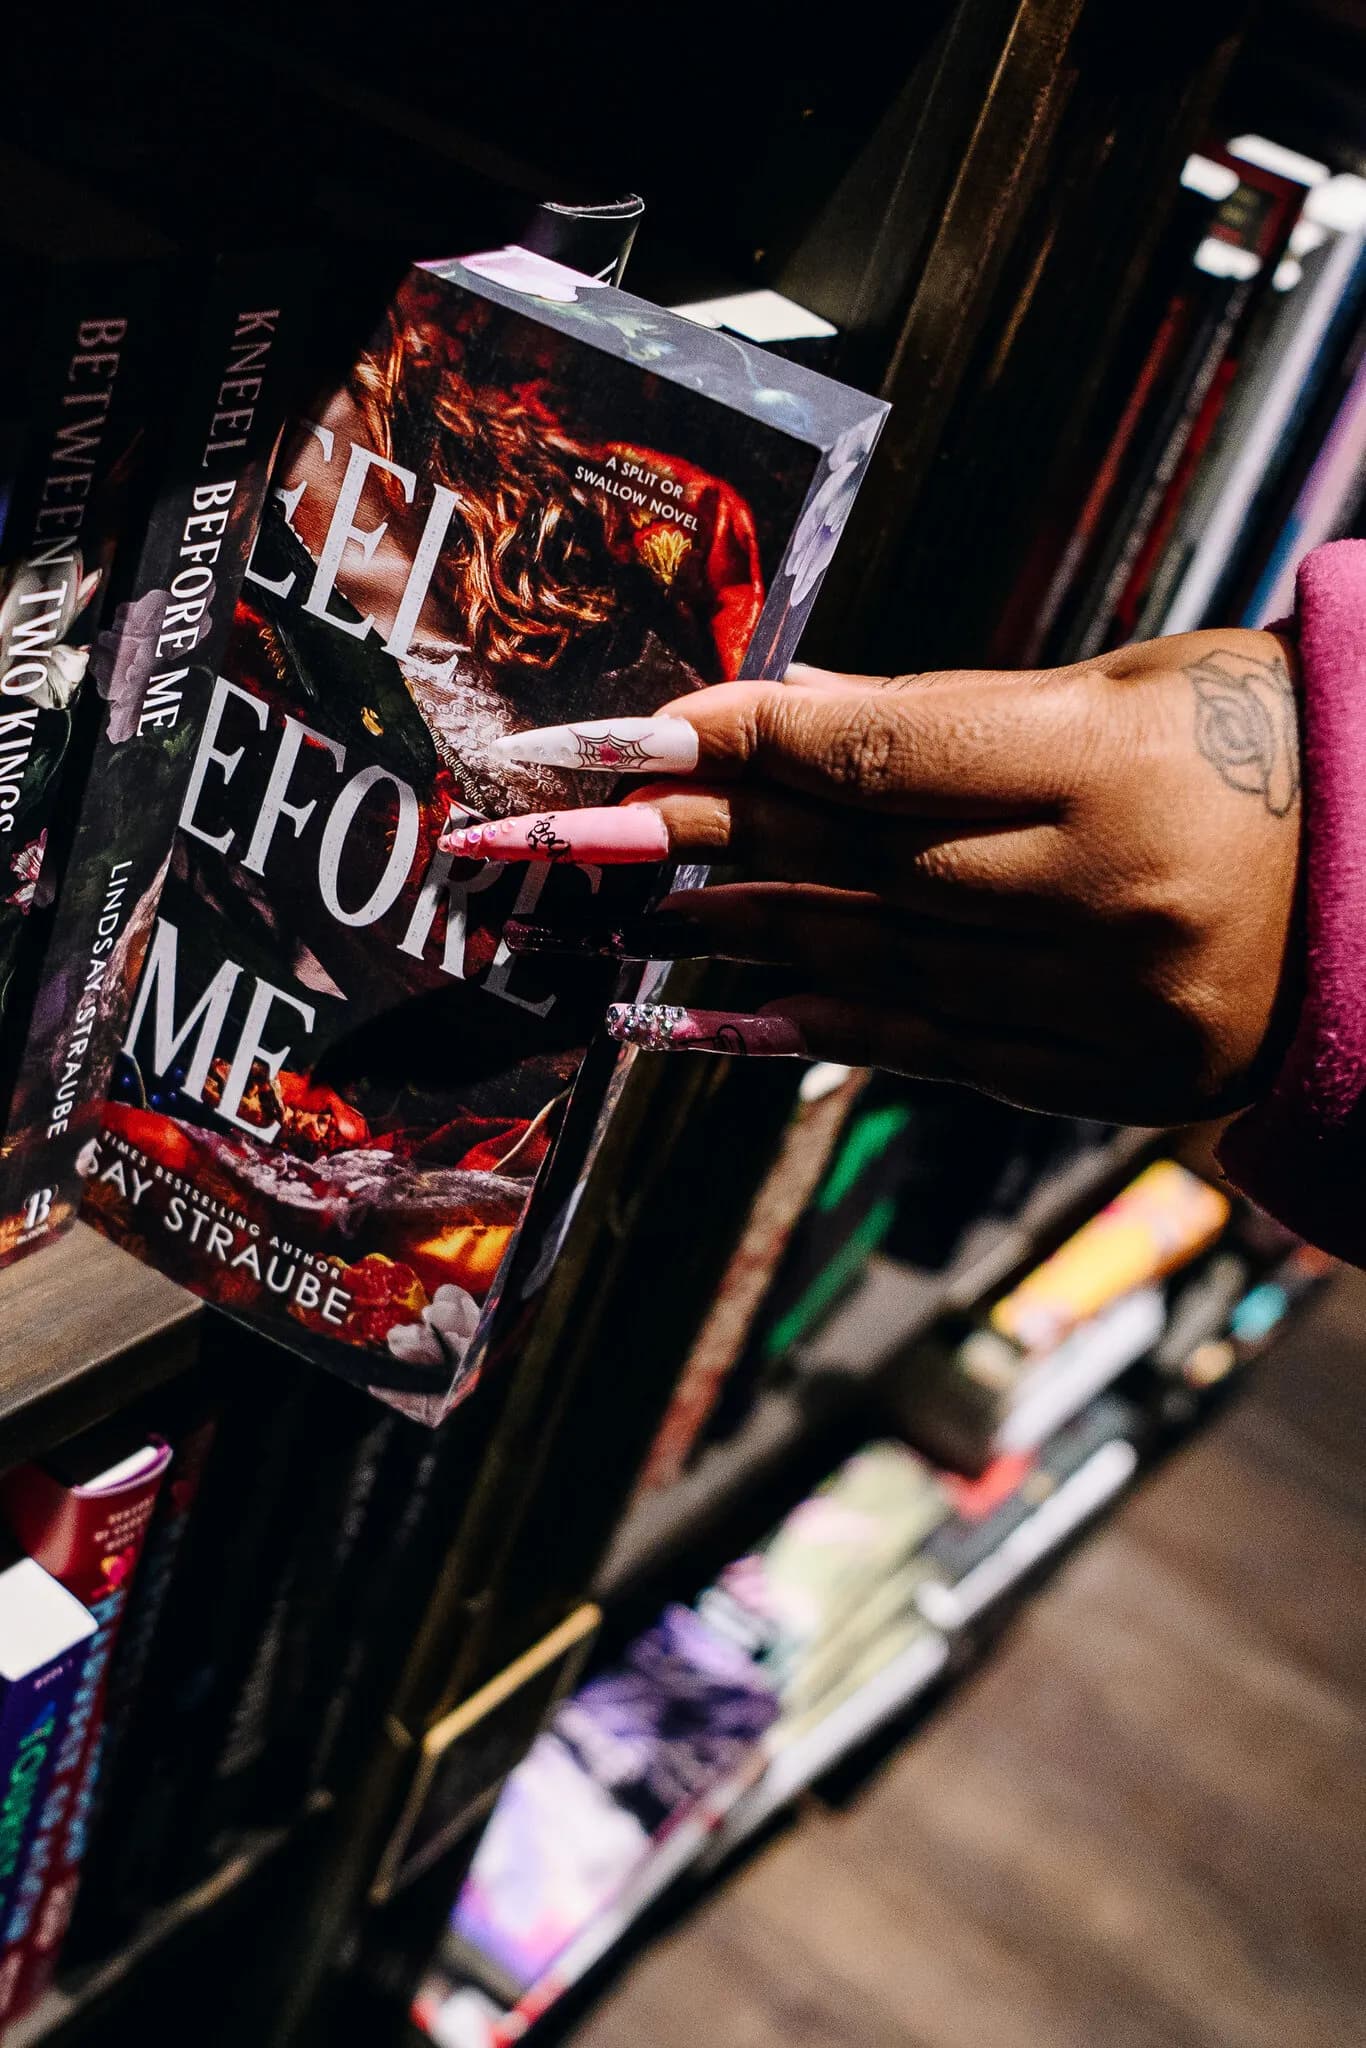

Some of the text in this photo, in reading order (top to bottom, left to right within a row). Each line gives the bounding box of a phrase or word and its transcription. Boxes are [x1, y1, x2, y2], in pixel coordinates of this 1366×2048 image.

[28, 316, 128, 568] BETWEEN
[574, 465, 699, 532] SWALLOW NOVEL
[605, 456, 684, 500] A SPLIT OR
[136, 307, 280, 738] KNEEL BEFORE ME
[1, 580, 68, 696] TWO
[46, 860, 133, 1140] LINDSAY STRAUBE
[121, 915, 316, 1144] ME
[103, 1130, 340, 1280] TIMES BESTSELLING AUTHOR
[163, 1196, 352, 1326] STRAUBE
